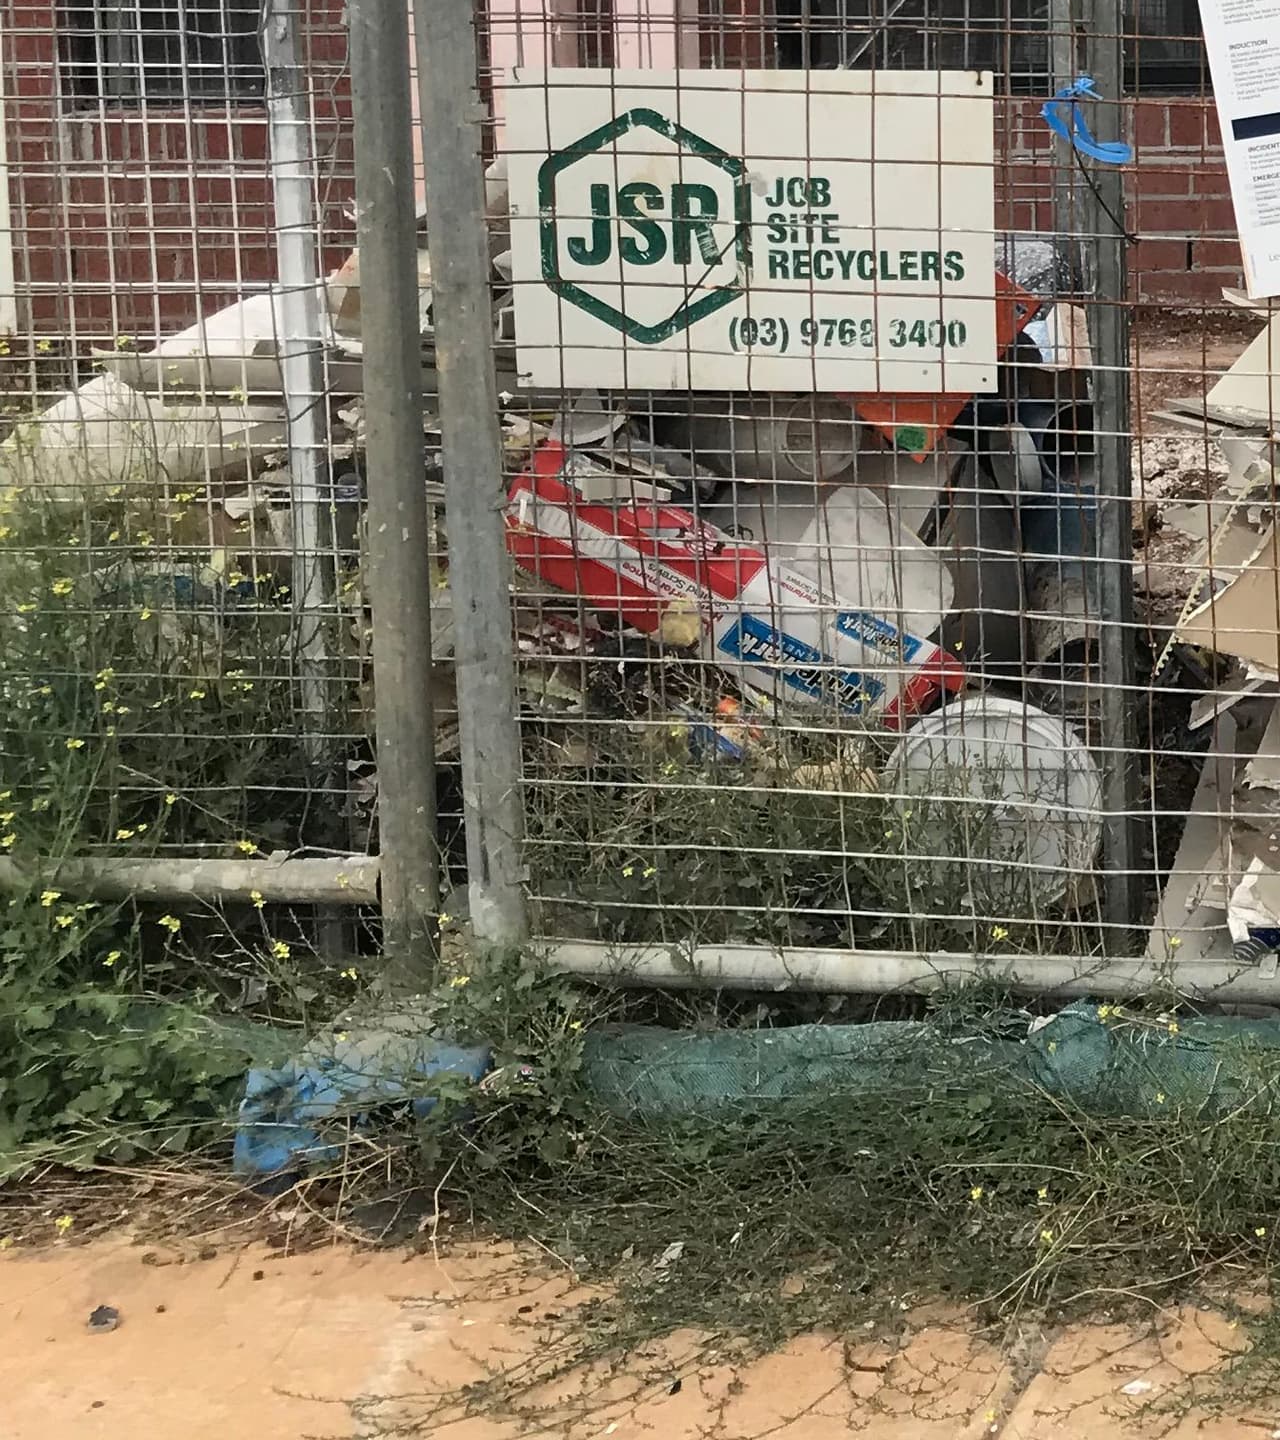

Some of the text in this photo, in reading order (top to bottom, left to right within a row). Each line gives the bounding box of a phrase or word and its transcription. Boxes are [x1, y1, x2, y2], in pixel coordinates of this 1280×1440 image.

[1228, 38, 1268, 50] INDUCTION
[766, 177, 832, 207] JOB
[567, 183, 721, 266] JSR
[768, 249, 966, 281] RECYCLERS
[729, 317, 789, 353] (03)
[889, 319, 967, 347] 3400
